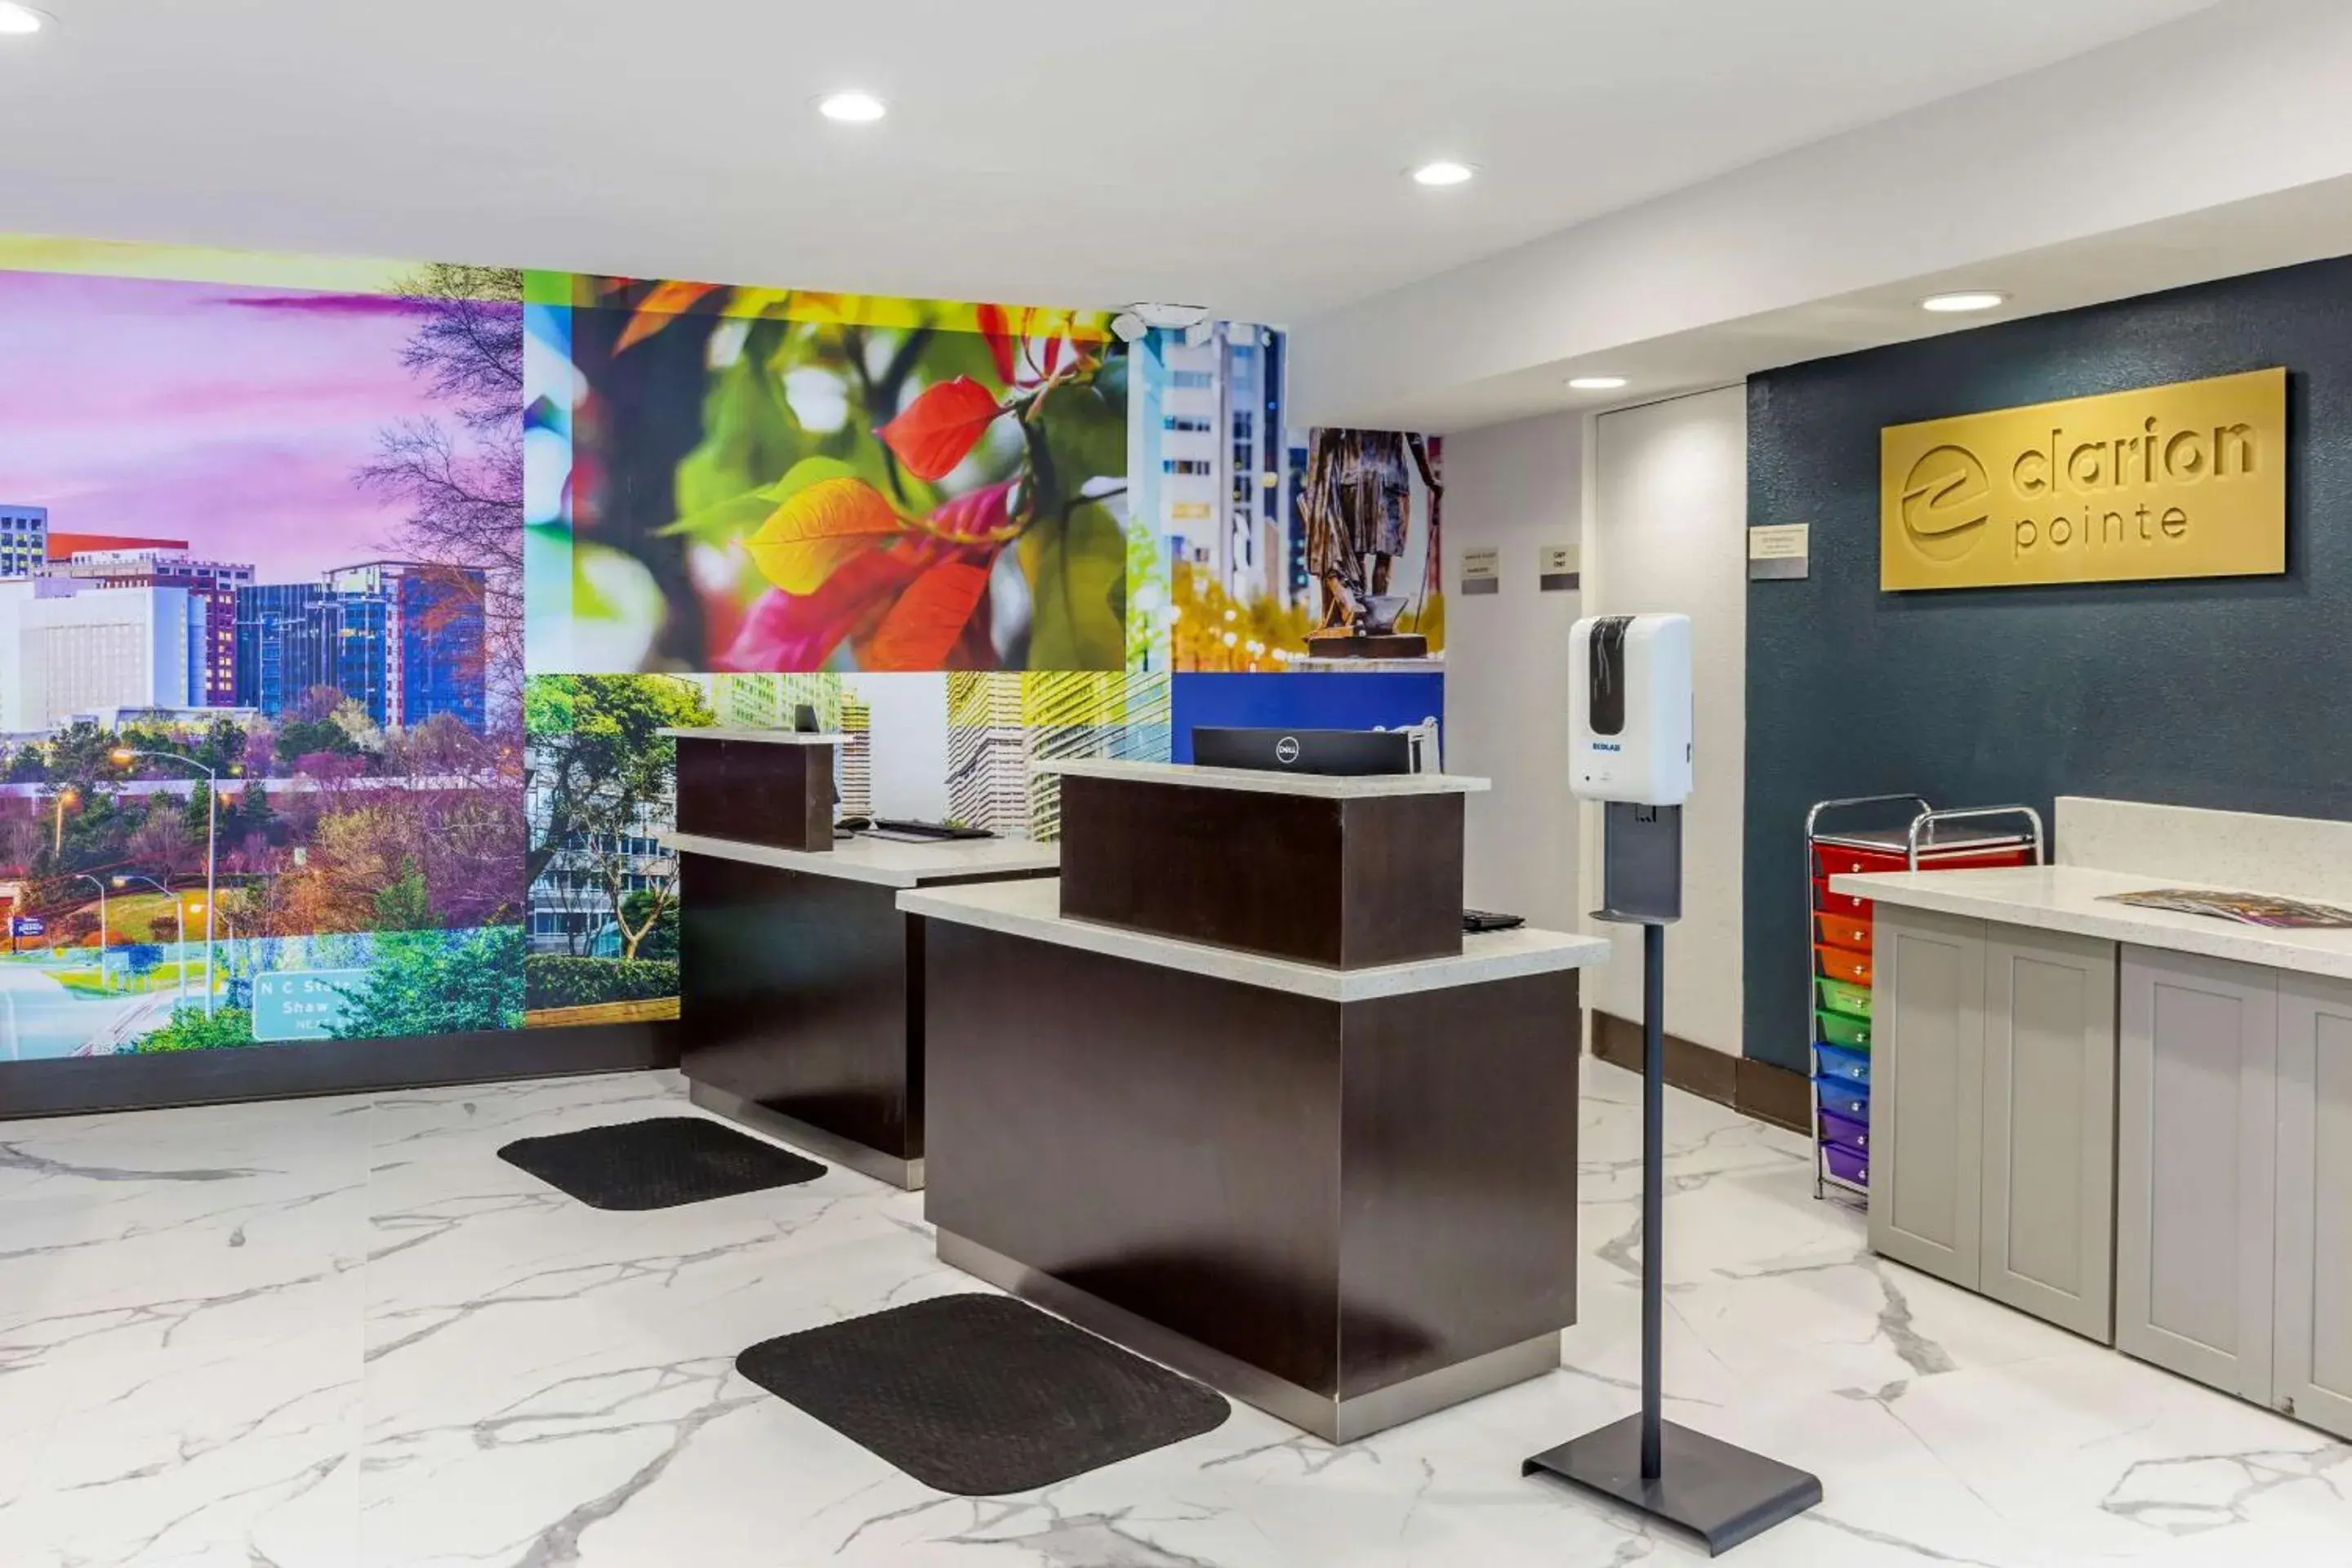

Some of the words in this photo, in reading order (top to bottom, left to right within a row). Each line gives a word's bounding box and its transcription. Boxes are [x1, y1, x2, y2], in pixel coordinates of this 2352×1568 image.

[2012, 416, 2261, 497] clarion
[2013, 503, 2190, 560] pointe
[1592, 742, 1621, 752] ECOLAB
[261, 982, 273, 995] N
[282, 981, 293, 994] C
[282, 1000, 330, 1014] Shaw
